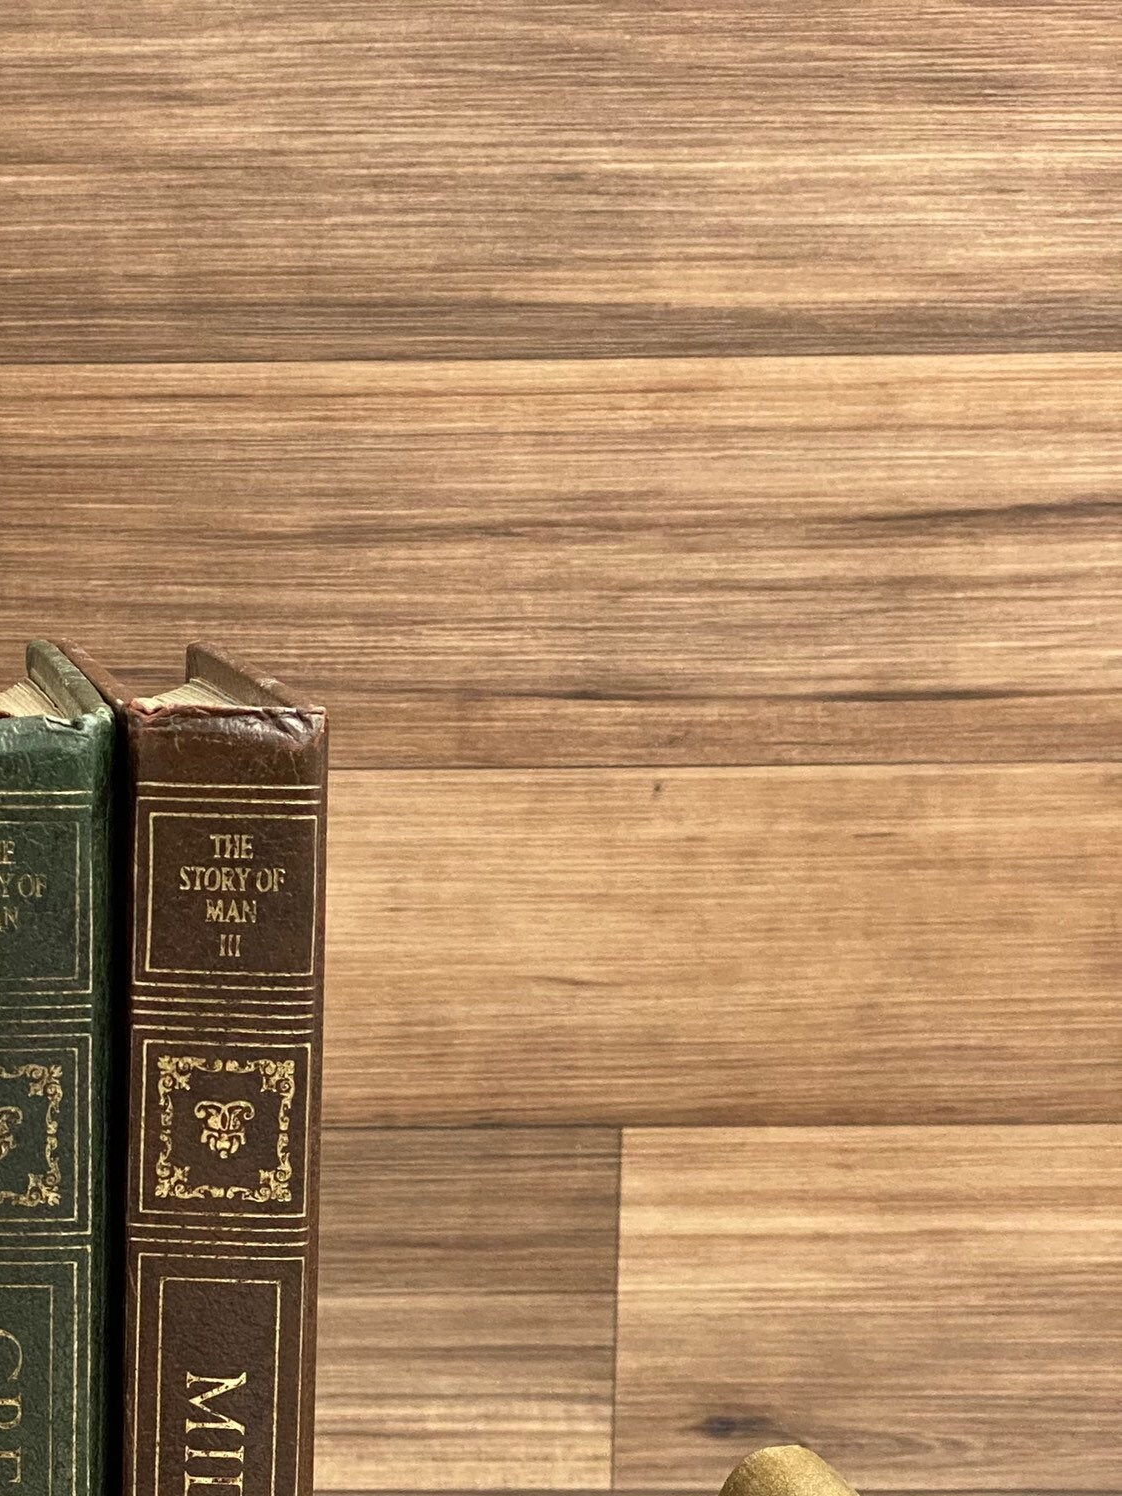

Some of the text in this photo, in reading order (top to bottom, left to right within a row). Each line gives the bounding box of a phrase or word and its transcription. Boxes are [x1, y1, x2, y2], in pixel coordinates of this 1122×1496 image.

[210, 834, 254, 859] THE
[18, 874, 48, 898] OF
[179, 866, 286, 892] STORY OF
[205, 899, 258, 923] MAN
[219, 934, 241, 958] III
